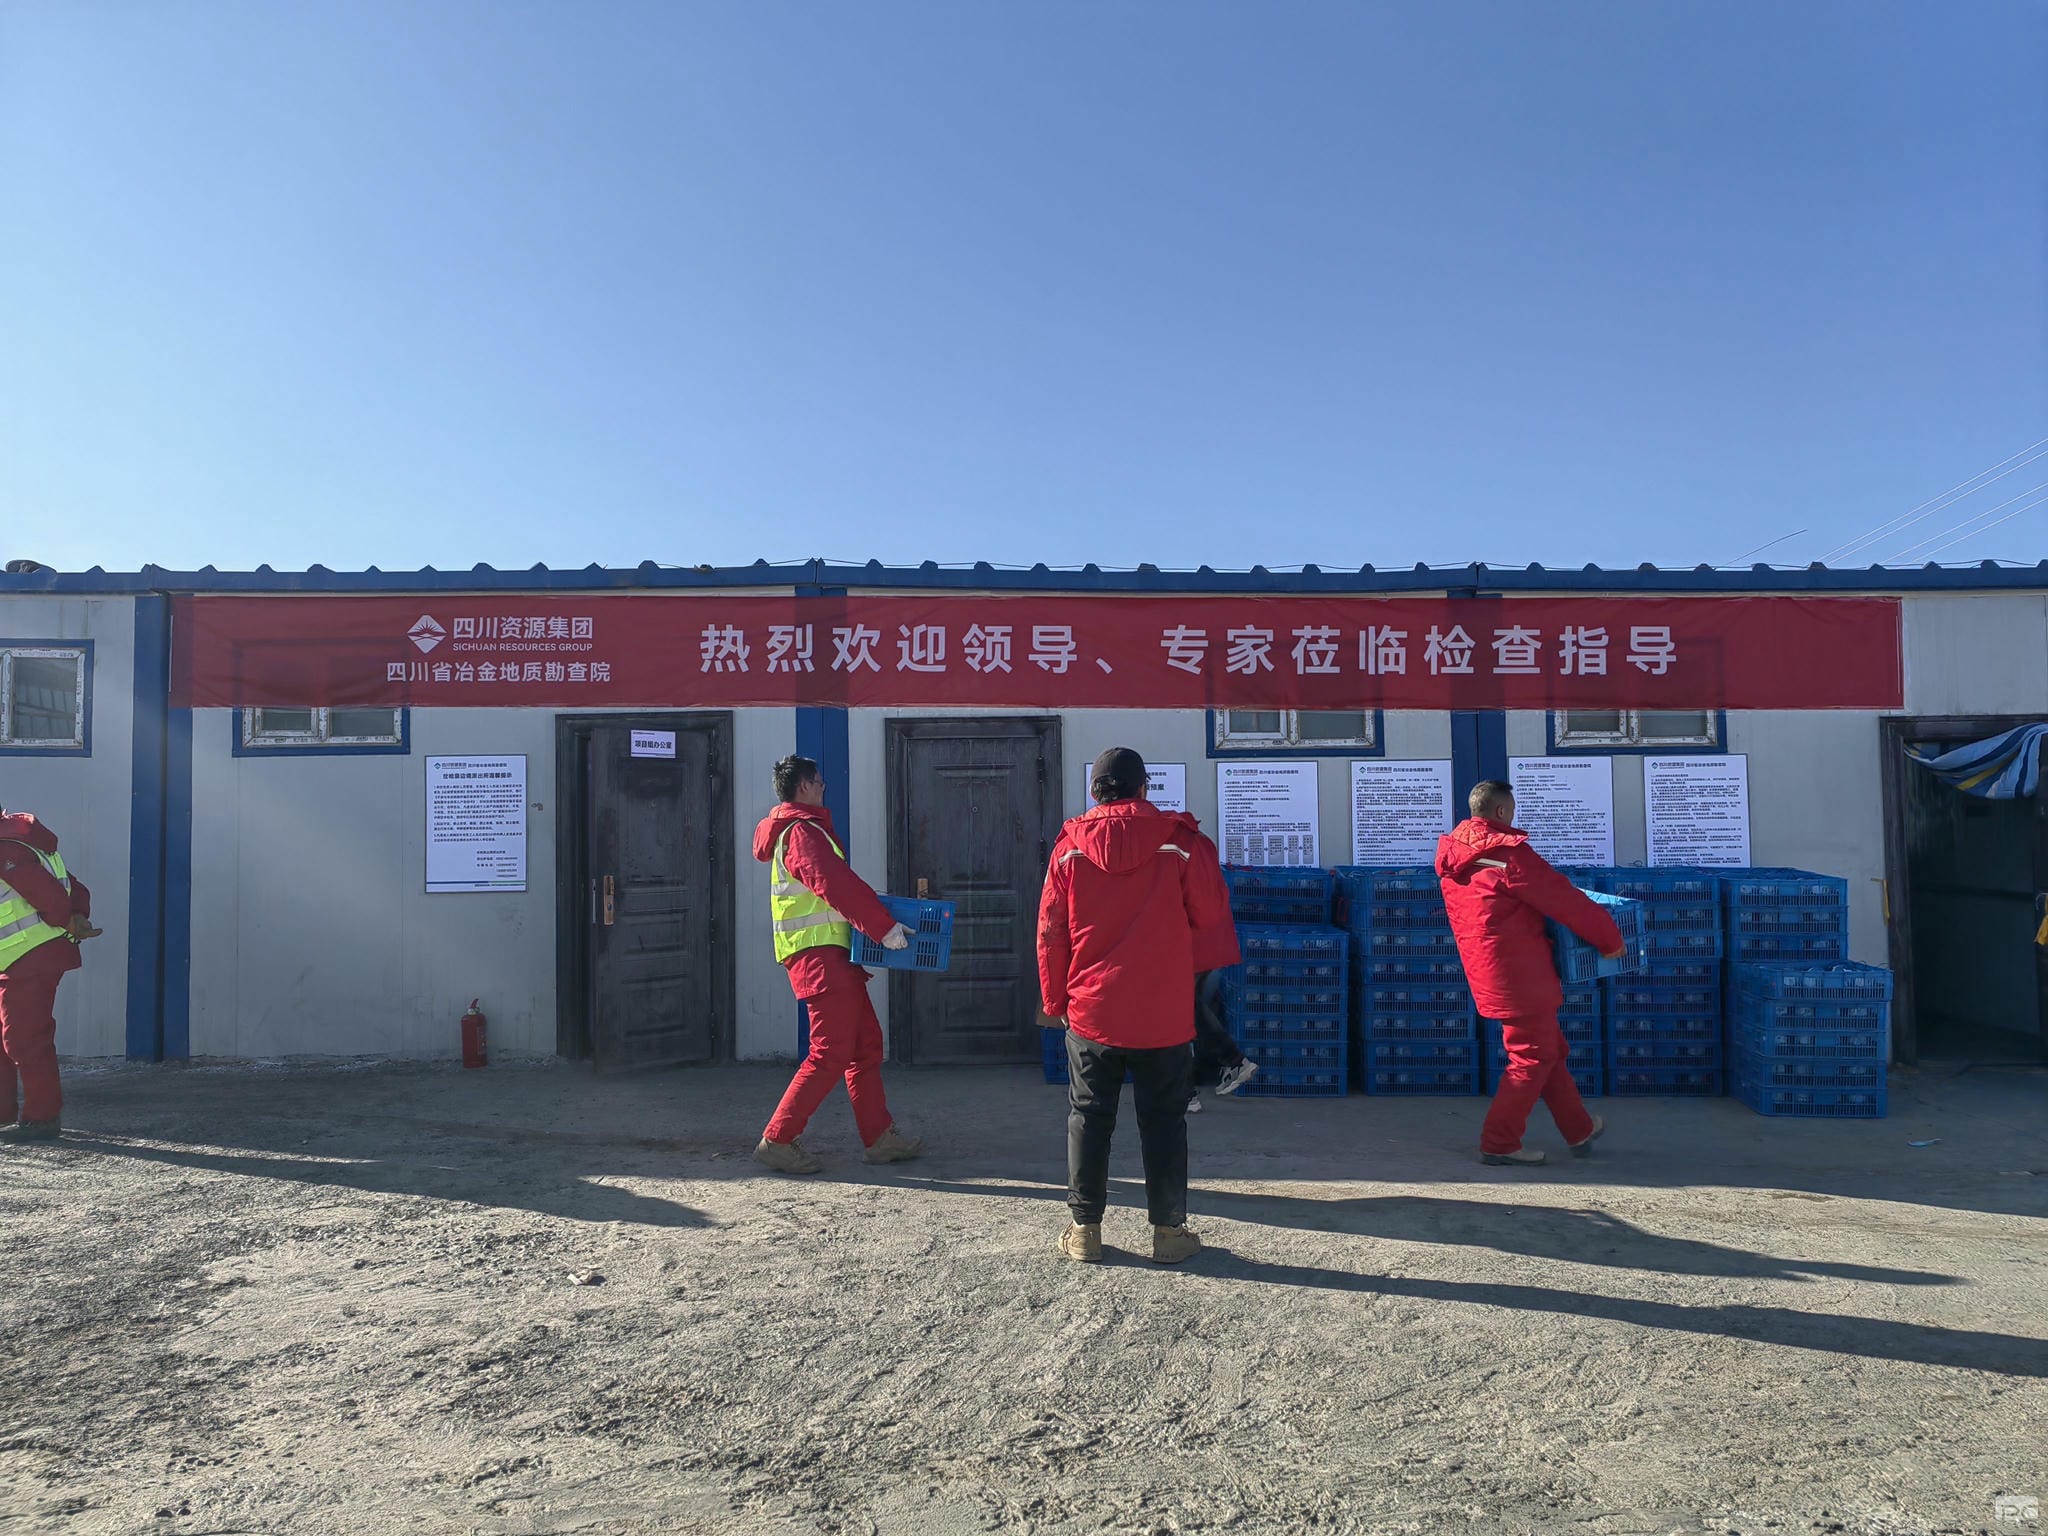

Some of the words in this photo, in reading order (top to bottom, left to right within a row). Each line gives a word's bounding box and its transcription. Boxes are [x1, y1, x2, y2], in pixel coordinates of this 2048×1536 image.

[453, 616, 593, 639] 四川资源集团
[452, 642, 497, 652] SICHUAN
[499, 642, 556, 652] RESOURCES
[558, 642, 593, 652] GROUP
[700, 623, 1678, 676] 热烈欢迎领导、专家莅临检查指导
[386, 661, 611, 683] 四川省冶金地质勘查院
[634, 740, 673, 749] 项目组办公室
